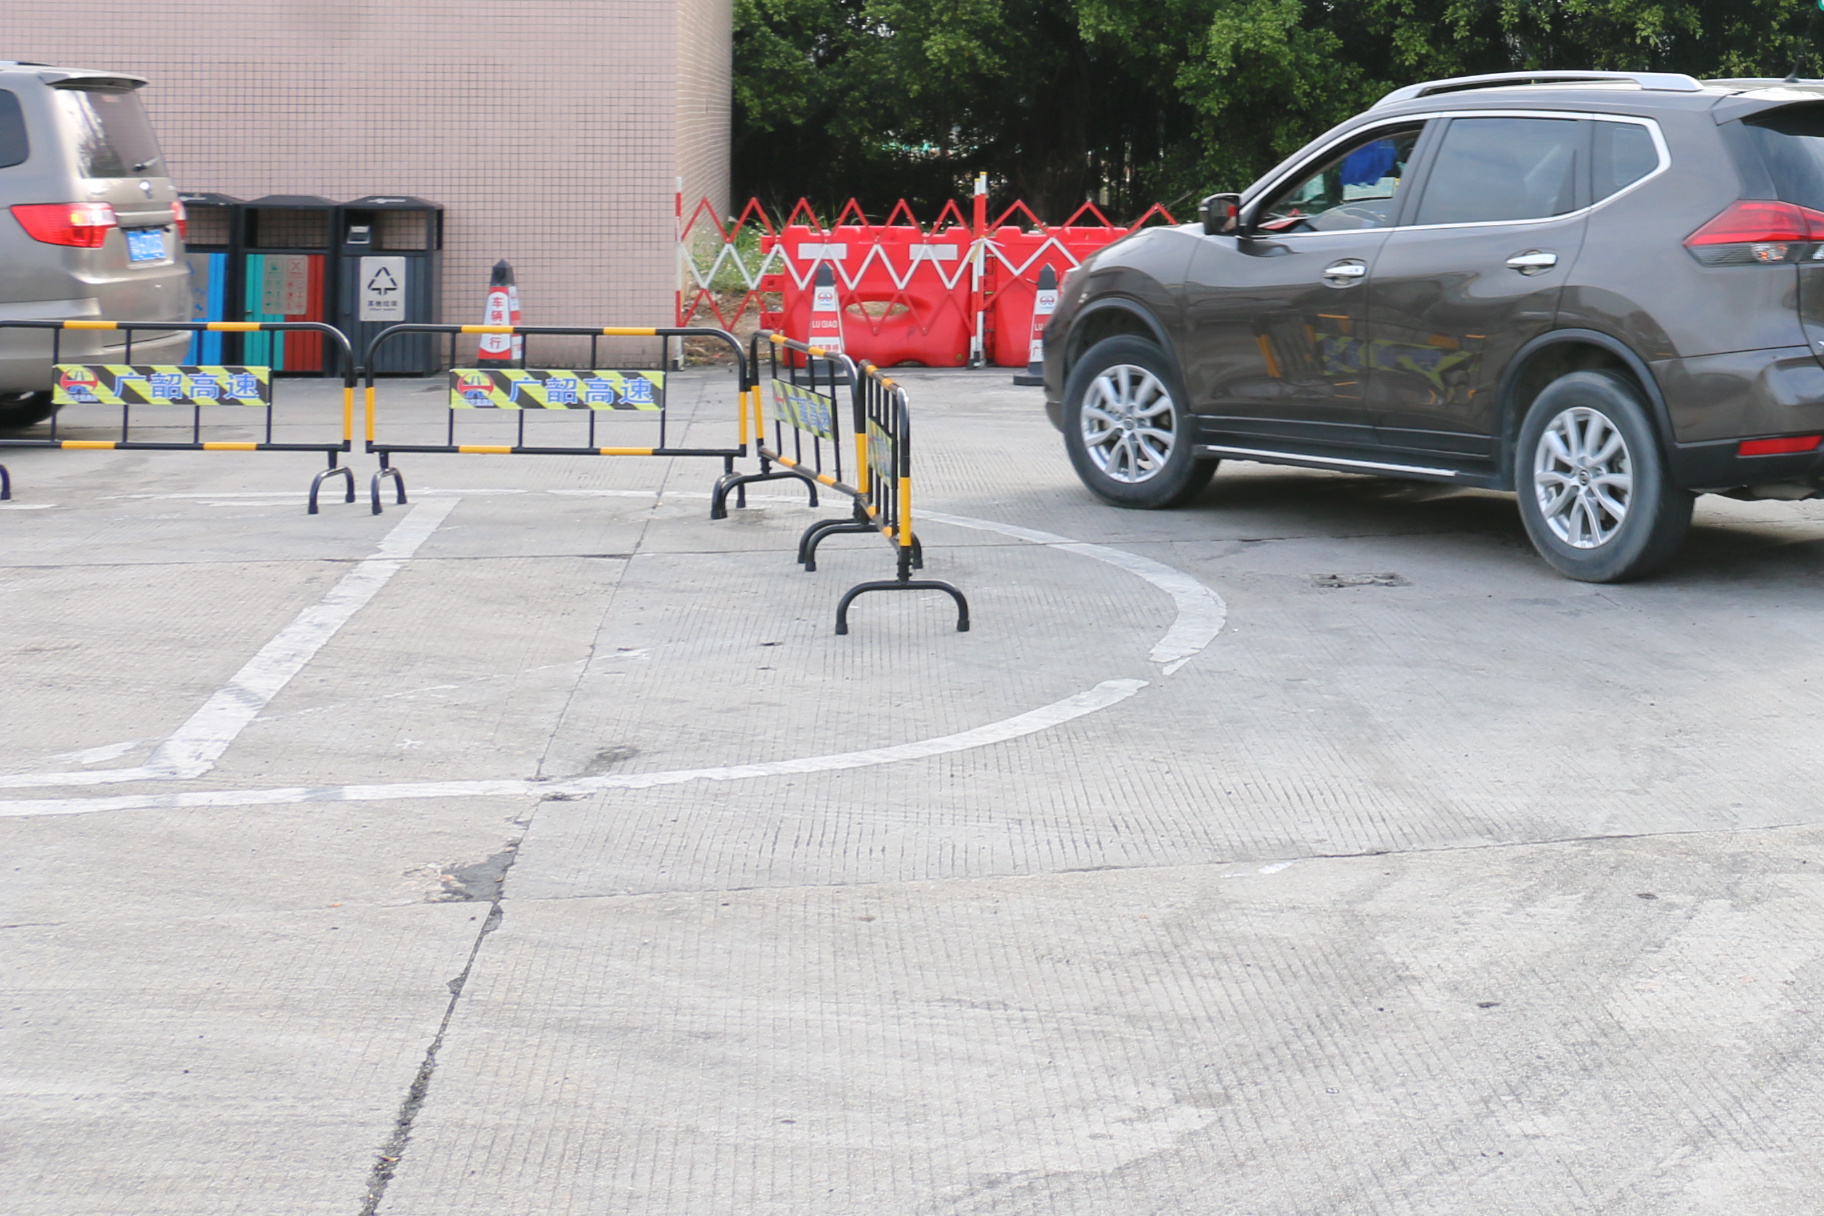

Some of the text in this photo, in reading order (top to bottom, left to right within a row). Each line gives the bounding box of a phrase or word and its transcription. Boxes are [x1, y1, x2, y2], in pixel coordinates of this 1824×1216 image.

[488, 296, 504, 349] 车辆行
[113, 372, 260, 400] 广韶高速
[508, 376, 655, 405] 广韶高速
